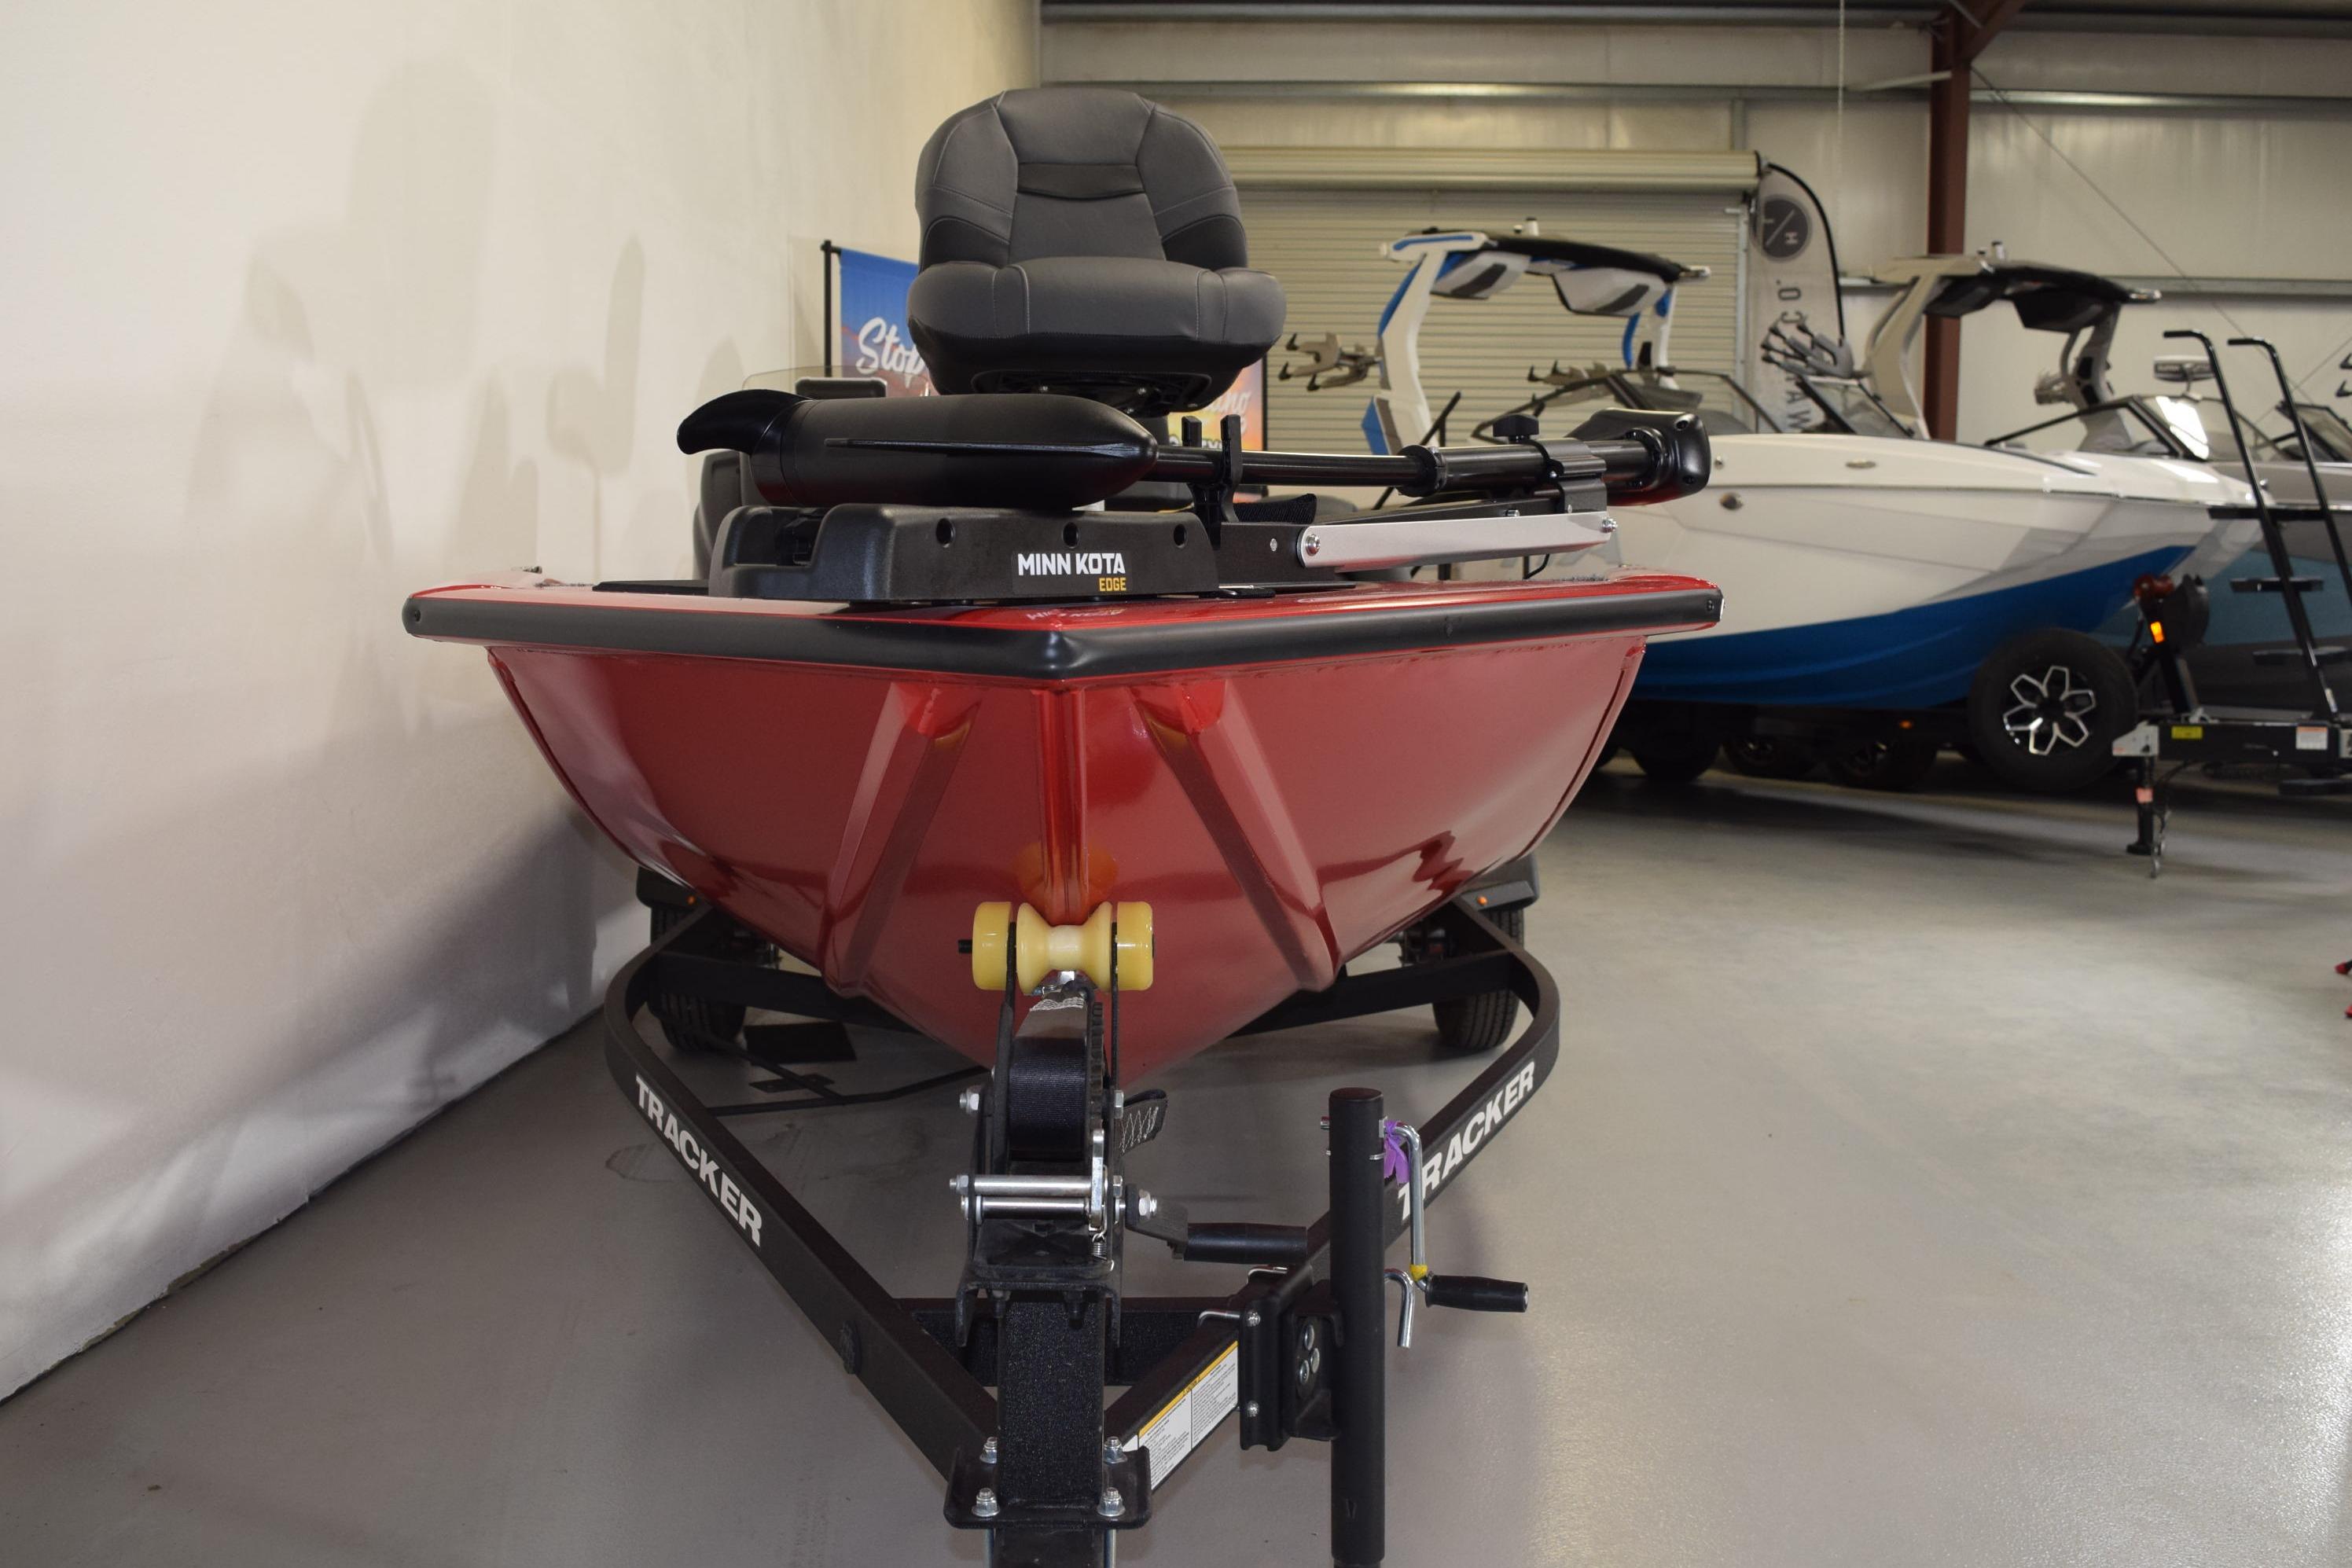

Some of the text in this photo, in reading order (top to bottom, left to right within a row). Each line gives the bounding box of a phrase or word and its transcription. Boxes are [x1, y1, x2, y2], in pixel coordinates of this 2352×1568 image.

[1017, 553, 1126, 576] MINN KOTA
[1099, 577, 1126, 591] EDGE
[635, 1074, 762, 1247] TRACKER
